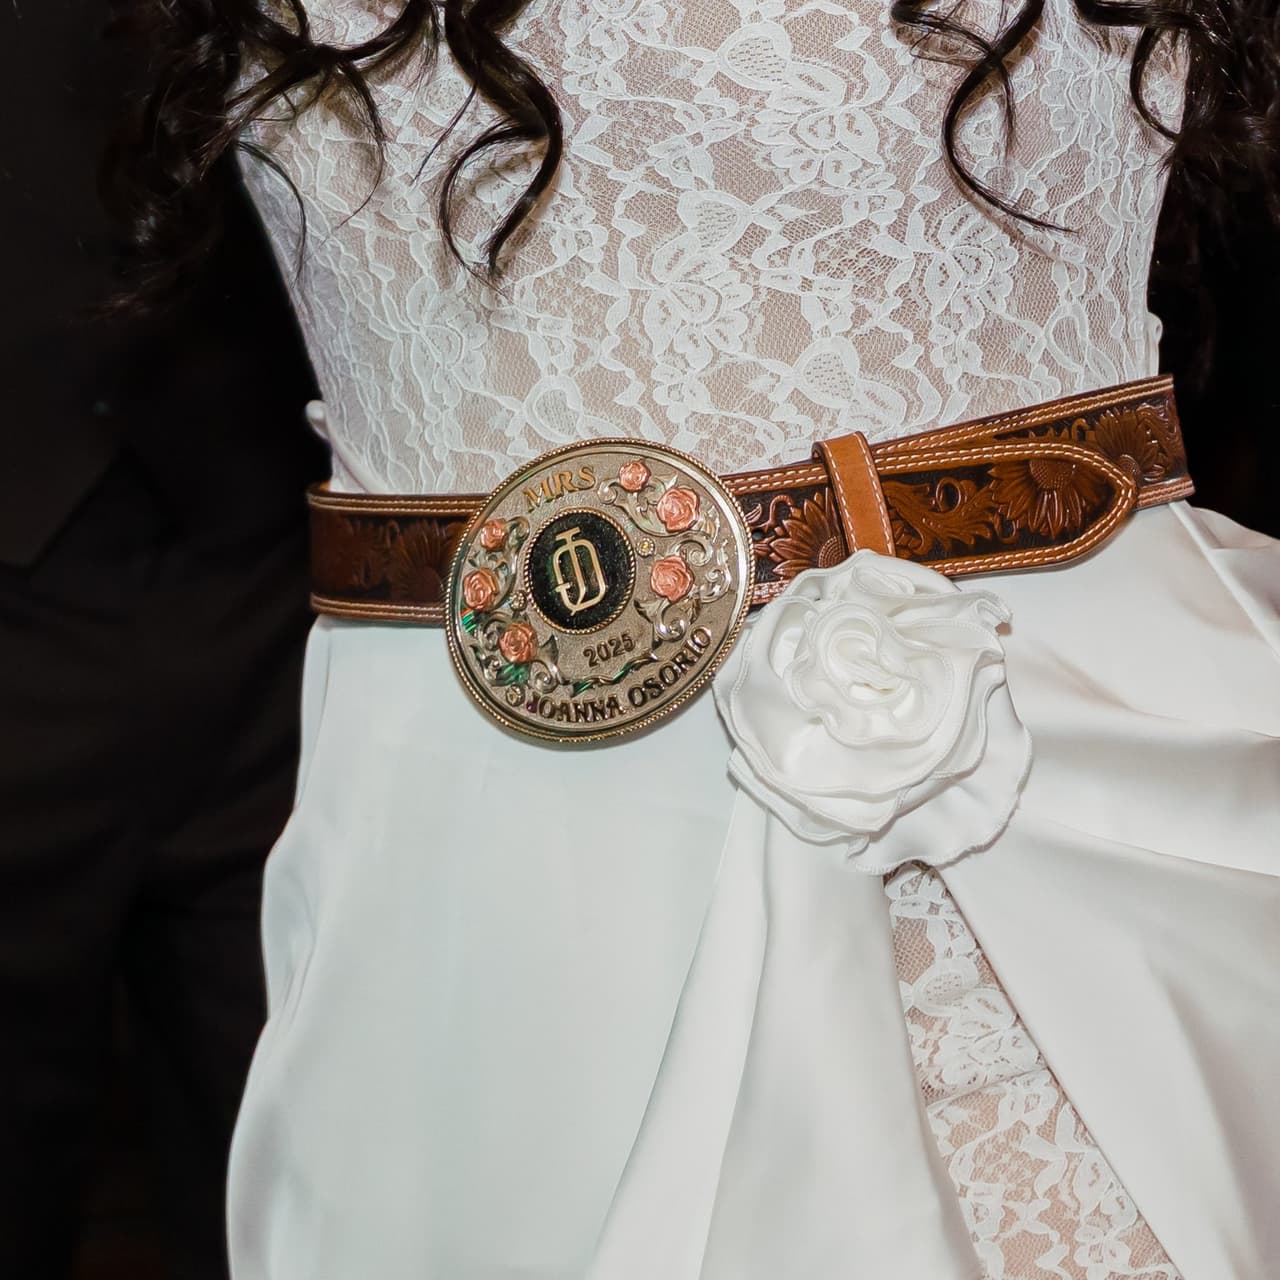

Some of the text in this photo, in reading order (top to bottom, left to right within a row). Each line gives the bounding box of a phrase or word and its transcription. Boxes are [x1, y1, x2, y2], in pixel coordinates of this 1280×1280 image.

[523, 466, 596, 513] MRS
[583, 633, 636, 667] 2025
[526, 626, 712, 722] JOANNA OSORIO
